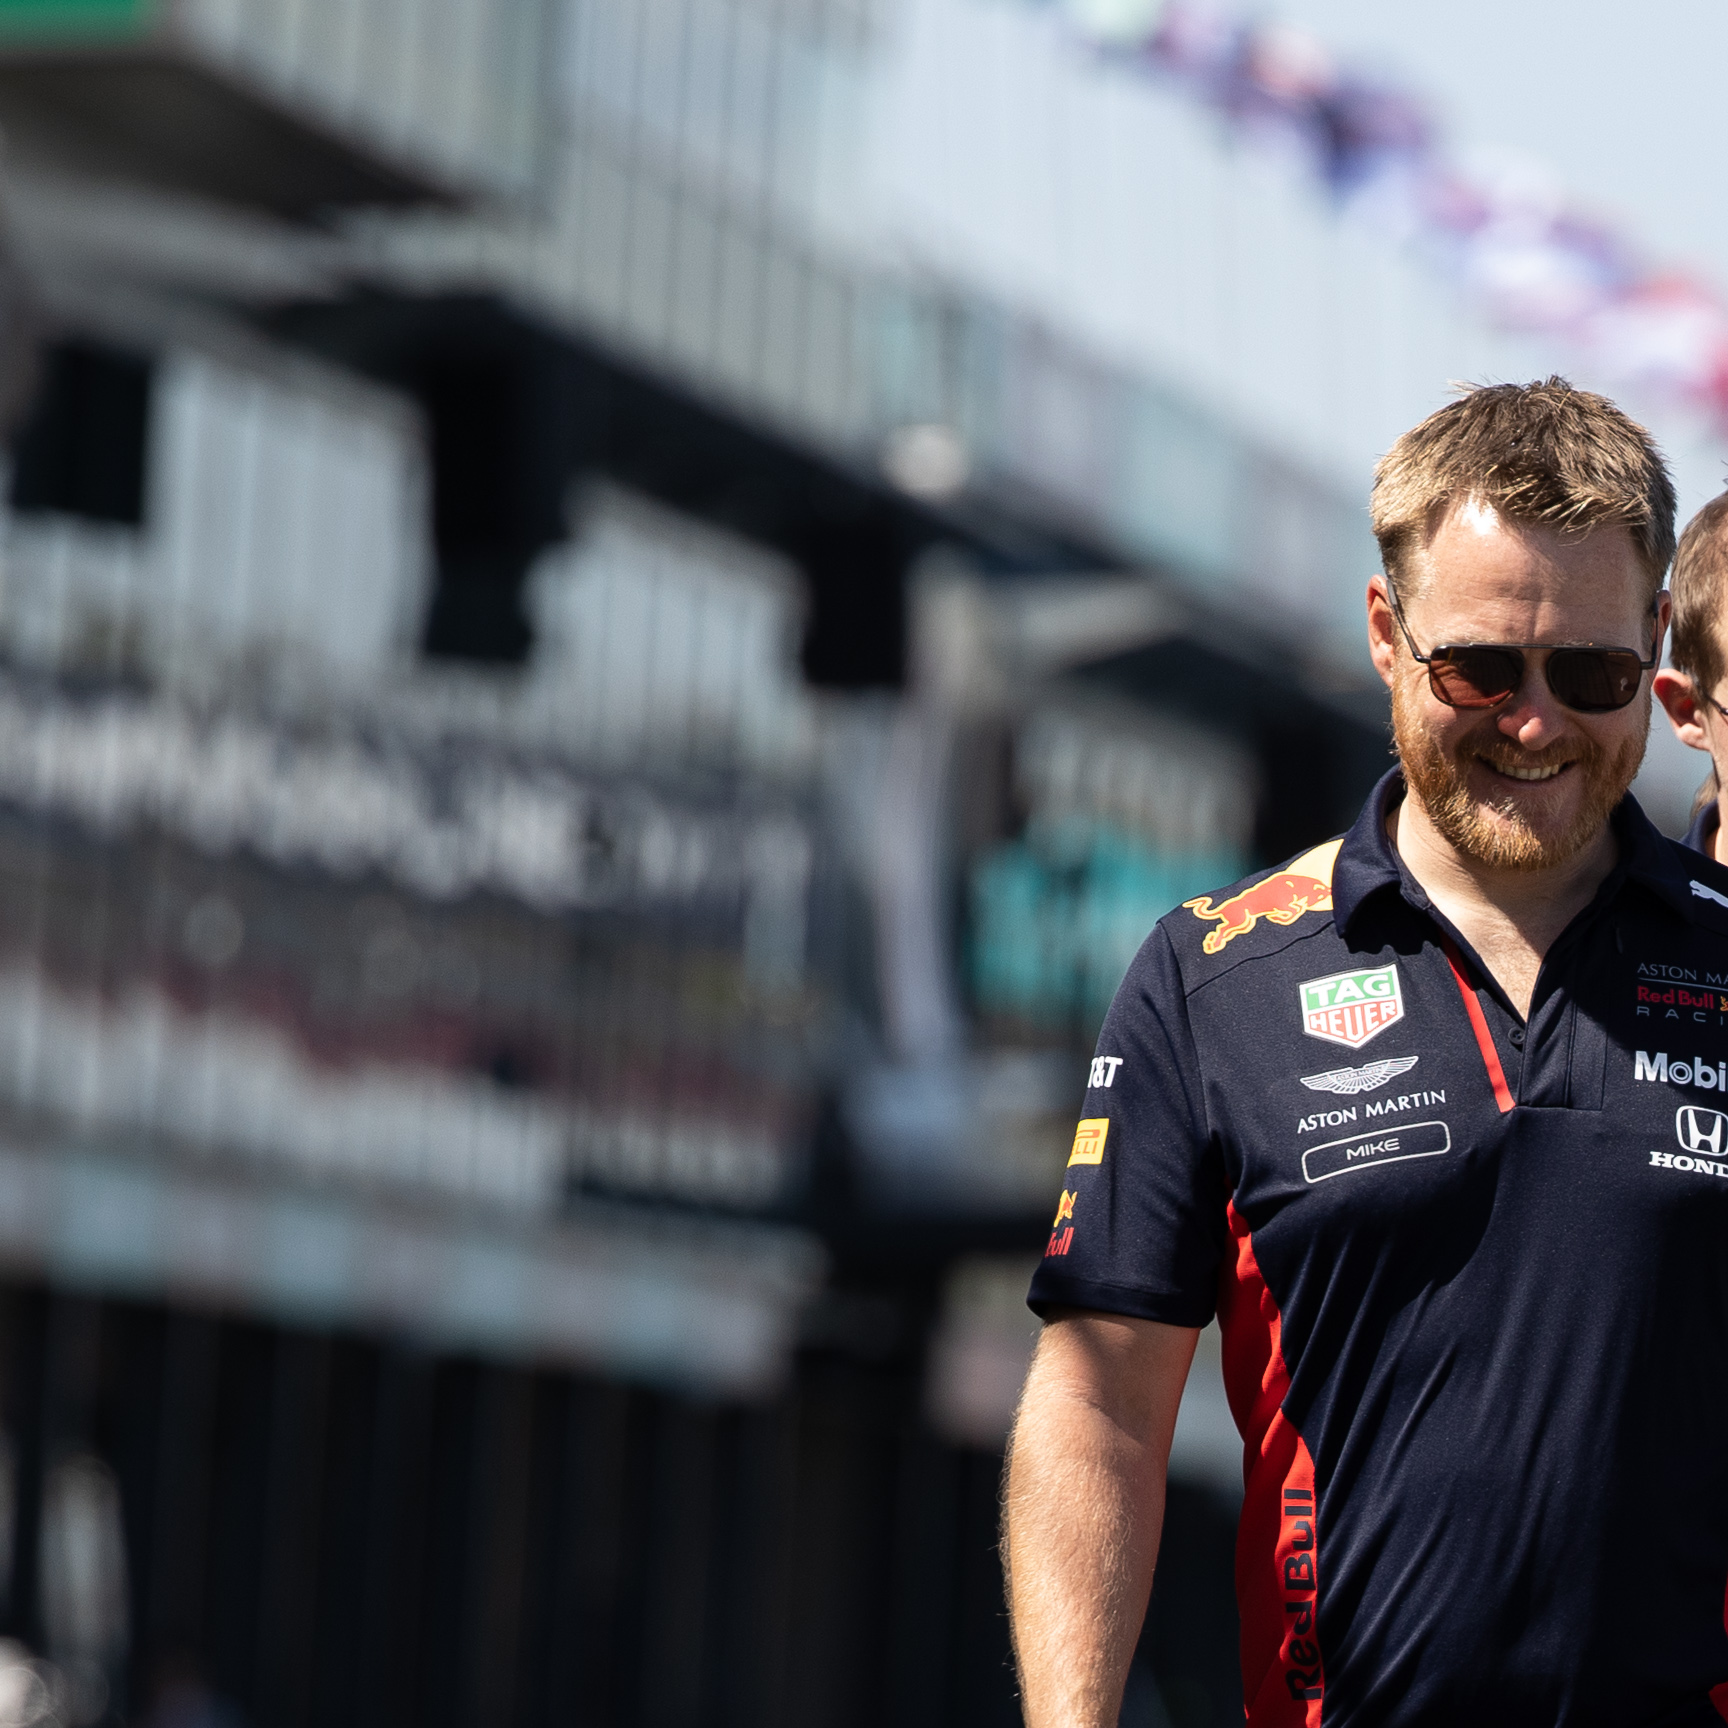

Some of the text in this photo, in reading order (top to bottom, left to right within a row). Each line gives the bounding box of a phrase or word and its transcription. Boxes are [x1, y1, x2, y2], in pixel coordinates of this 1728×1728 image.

[1637, 963, 1697, 981] ASTON
[1309, 974, 1390, 1006] TAG
[1637, 986, 1715, 1009] Red Bull
[1309, 1001, 1396, 1040] HEUER
[1297, 1090, 1446, 1134] ASTON MARTIN
[1346, 1137, 1400, 1160] MIKE
[1283, 1488, 1325, 1701] Red Bull
